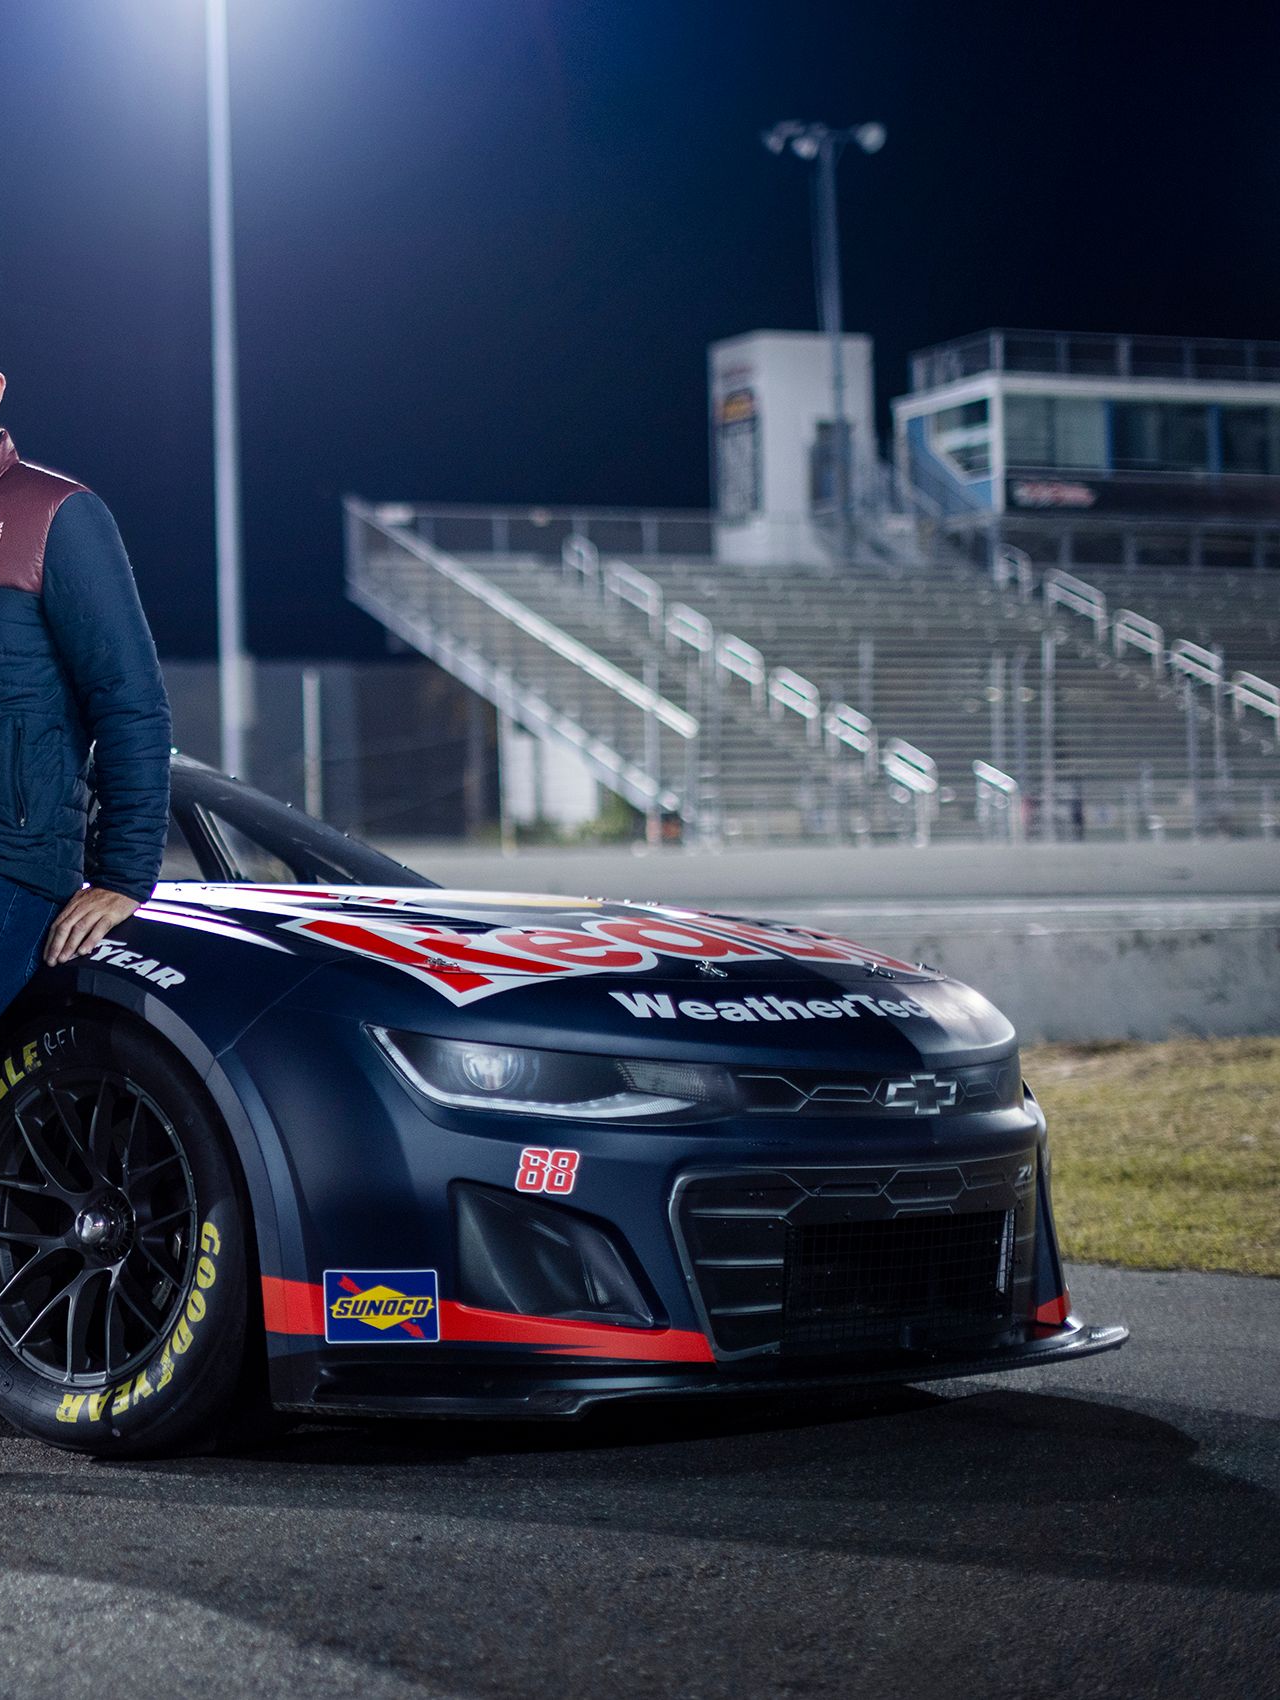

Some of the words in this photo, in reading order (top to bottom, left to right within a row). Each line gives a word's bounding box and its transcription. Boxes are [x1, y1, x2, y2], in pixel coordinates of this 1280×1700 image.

[88, 939, 186, 989] YEAR
[515, 1148, 579, 1194] 88
[56, 1221, 221, 1423] GOODYEAR
[336, 1299, 430, 1317] SUNOCO
